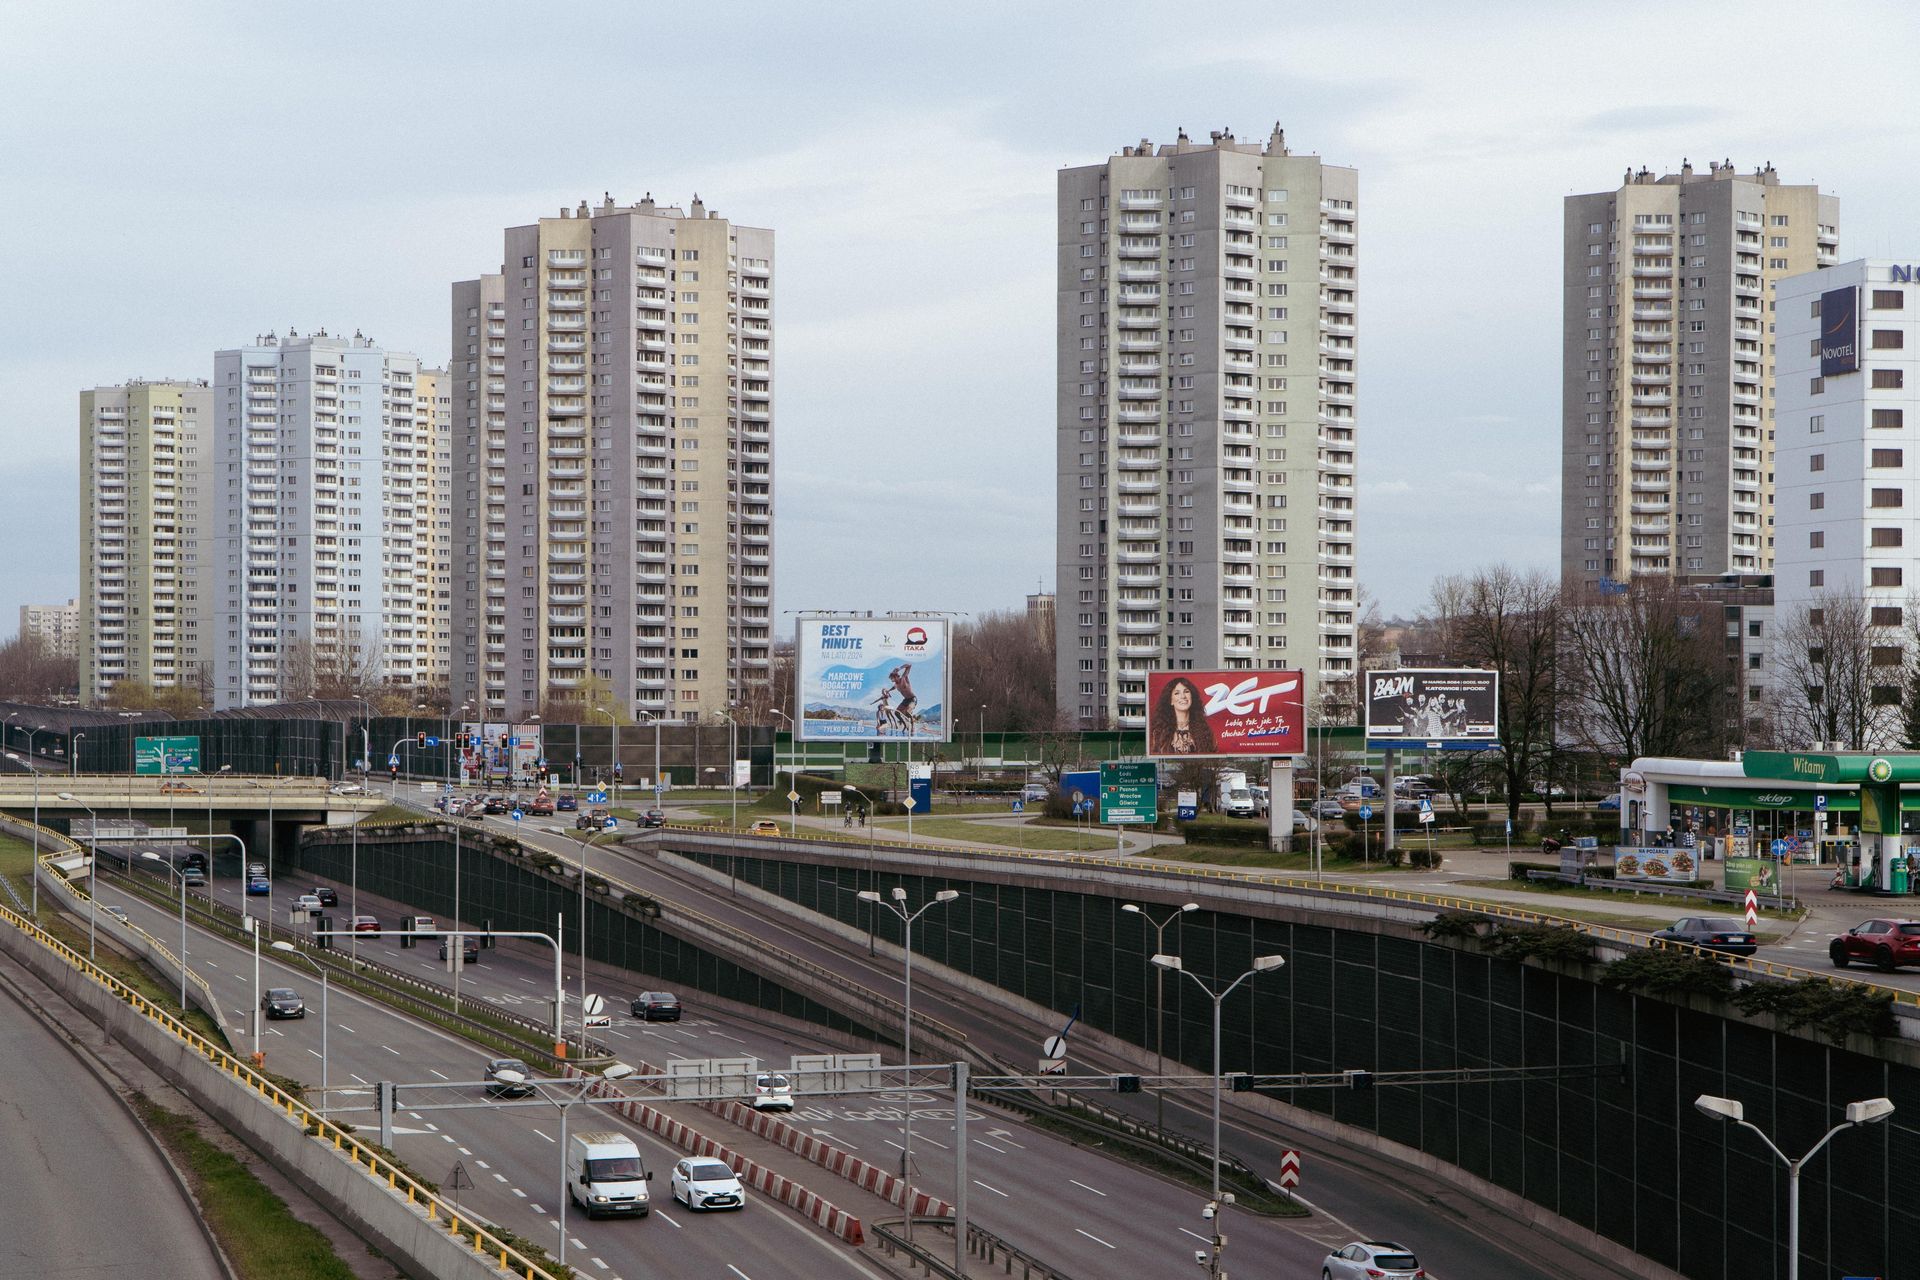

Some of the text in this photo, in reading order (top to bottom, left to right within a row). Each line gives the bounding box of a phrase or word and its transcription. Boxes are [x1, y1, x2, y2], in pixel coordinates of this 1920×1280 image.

[1891, 264, 1920, 283] N
[1823, 344, 1853, 360] NOVOTEL
[822, 625, 850, 636] BEST
[822, 638, 863, 649] MINUTE
[828, 672, 864, 682] MARCOWE
[822, 682, 862, 690] BOGACTWO
[1374, 676, 1415, 697] BAJM
[826, 690, 850, 699] OFERT
[1203, 676, 1298, 716] ZET
[1257, 718, 1272, 728] jak
[1793, 757, 1826, 780] Witamy
[1756, 793, 1793, 806] sklep
[1817, 796, 1825, 806] P
